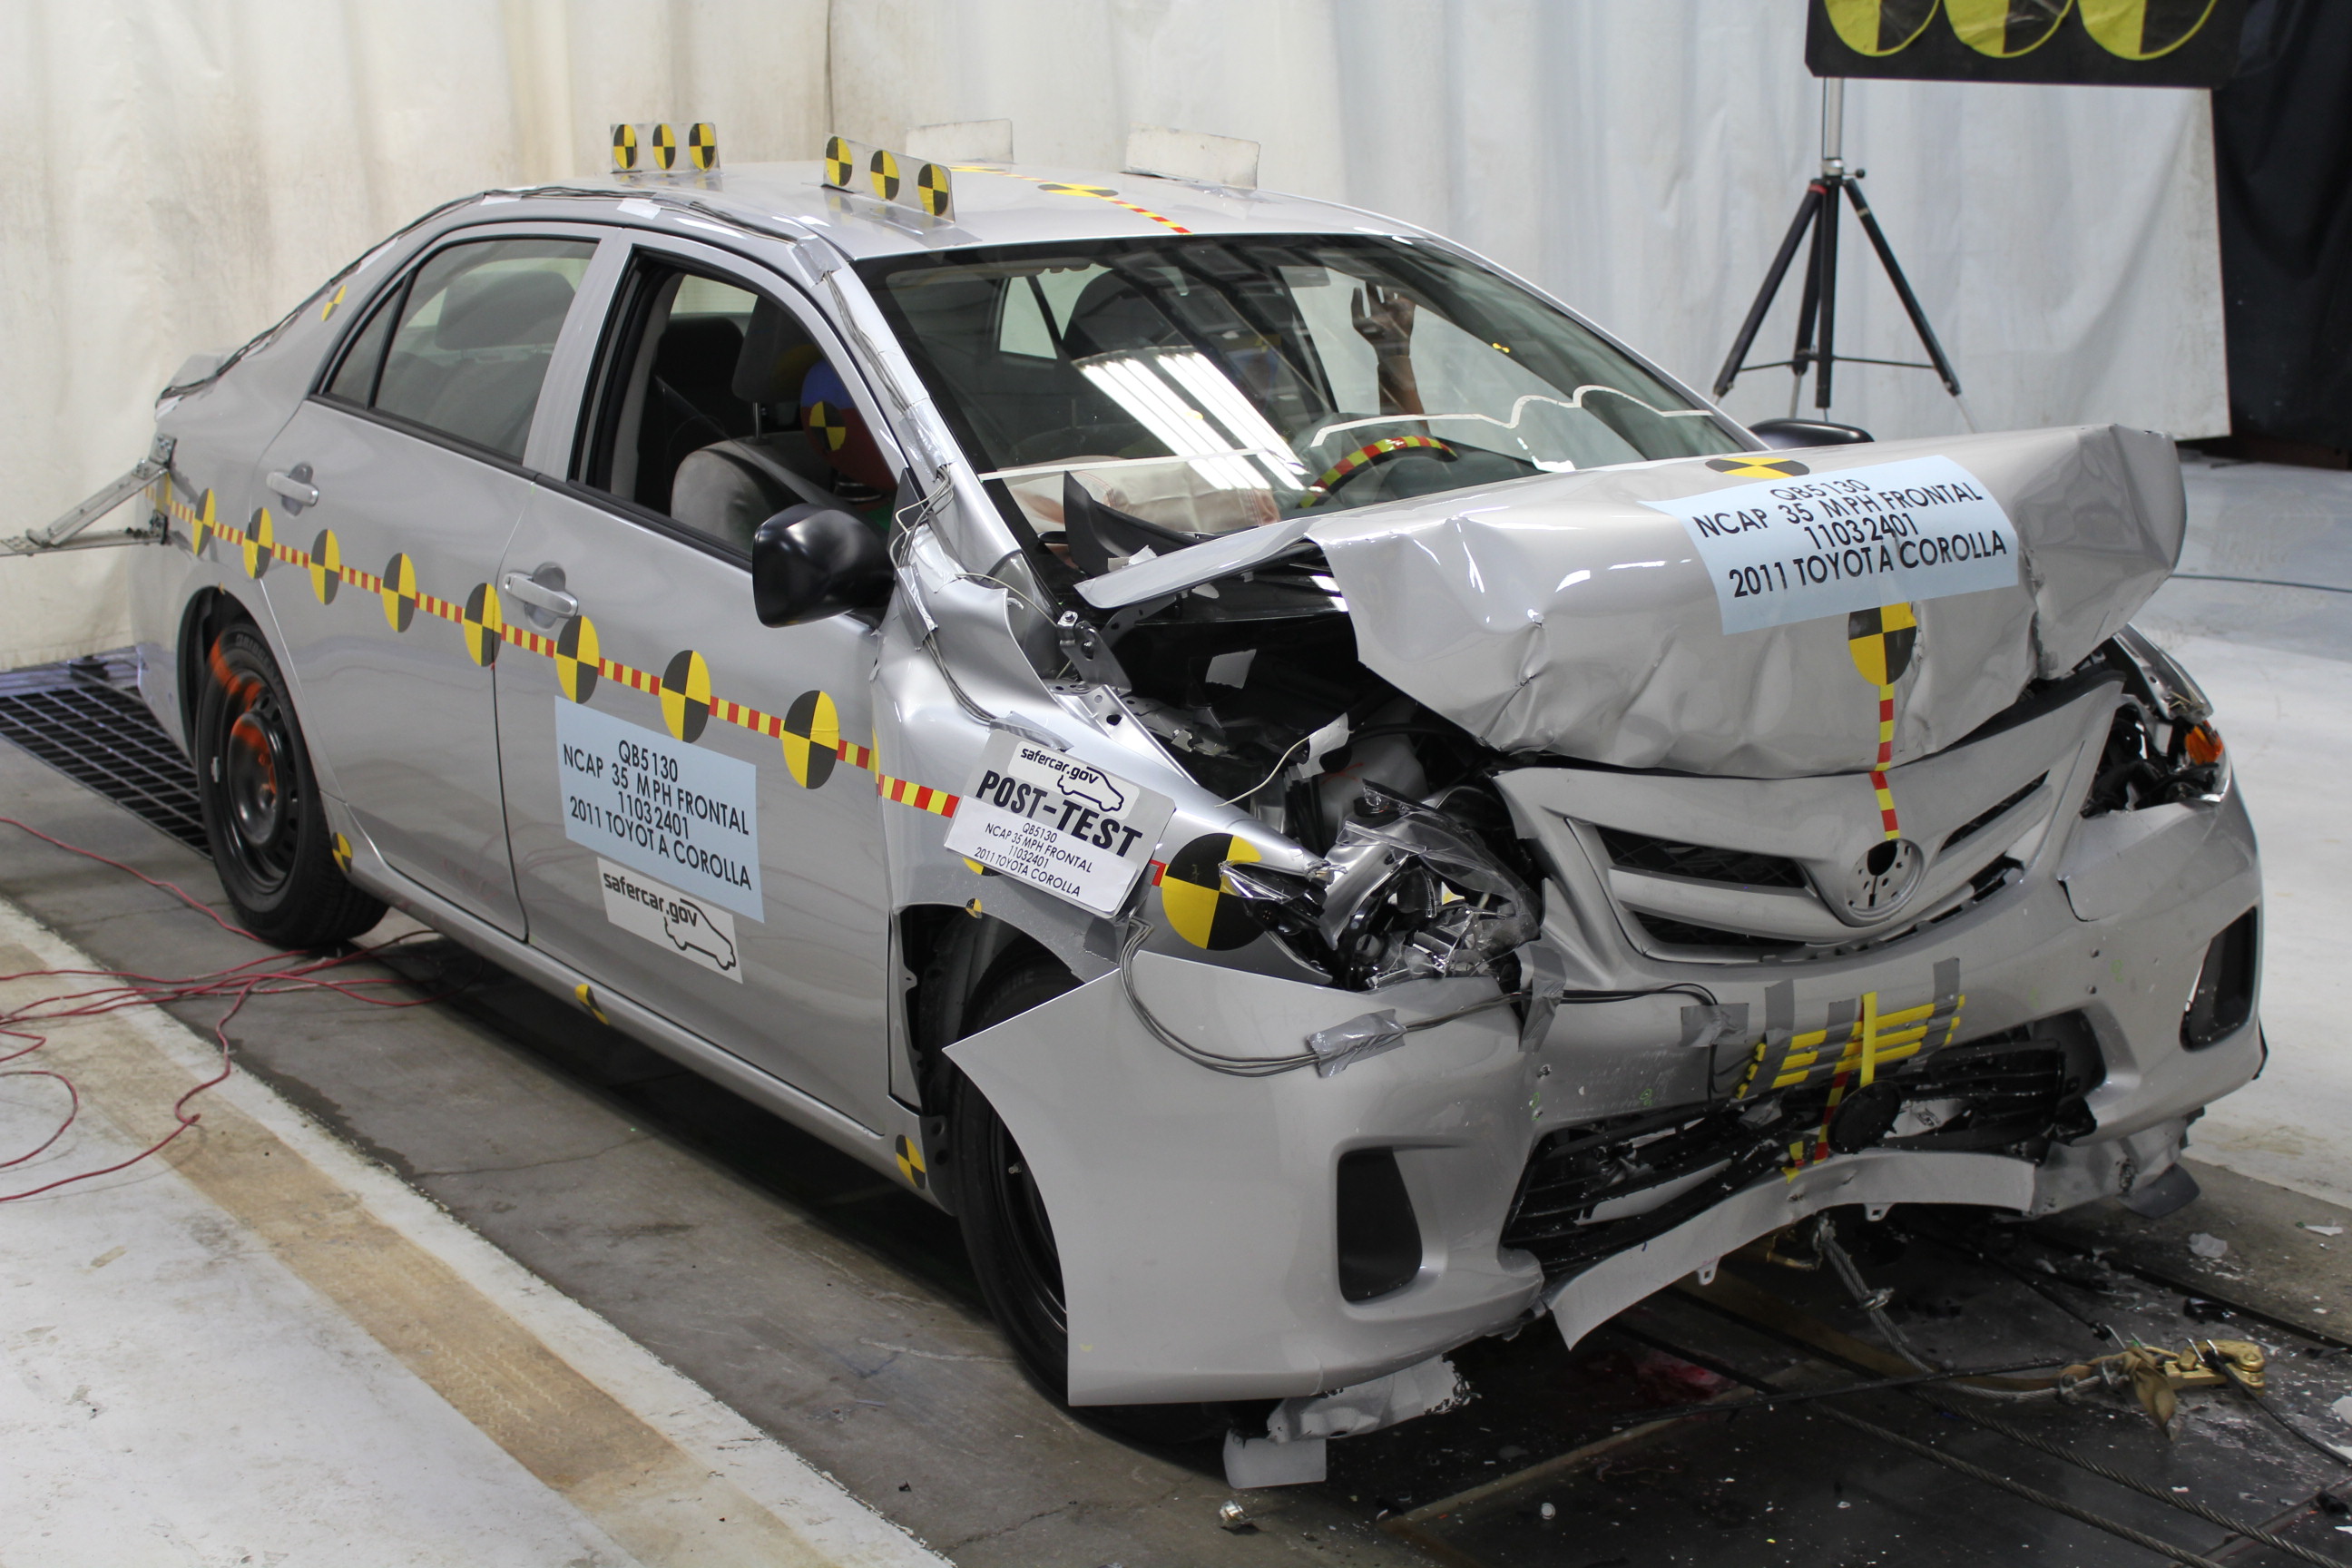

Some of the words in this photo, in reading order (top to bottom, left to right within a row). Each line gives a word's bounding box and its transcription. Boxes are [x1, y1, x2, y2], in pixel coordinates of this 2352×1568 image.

[1692, 507, 1768, 537] NCAP
[1779, 503, 1814, 524] 35
[1818, 494, 1882, 518] MPH
[1884, 482, 1983, 511] FRONTAL
[1770, 479, 1870, 501] QB5130
[1804, 513, 1919, 550] 11032401
[1730, 562, 1788, 597] 2011
[1793, 544, 1894, 586] TOYOTA
[1899, 529, 2007, 569] COROLLA
[619, 740, 678, 782] QB5130
[1021, 749, 1099, 784] safercar.gov
[564, 743, 603, 778] NCAP
[612, 763, 628, 789] 35
[637, 773, 671, 807] MPH
[678, 789, 749, 835] FRONTAL
[975, 769, 1142, 858] POST-TEST
[619, 792, 689, 839] 11032401
[1023, 823, 1057, 843] QB5130
[570, 796, 602, 828] 2011
[606, 810, 670, 858] TOYOTA
[674, 840, 751, 890] COROLLA
[985, 823, 1011, 841] NCAP
[1012, 832, 1023, 845] 35
[1022, 838, 1044, 851] MPH
[1044, 845, 1092, 873] FRONTAL
[1008, 846, 1049, 868] 11032401
[975, 848, 995, 864] 2011
[995, 857, 1028, 876] TOYOTA
[1031, 868, 1081, 897] COROLLA
[603, 873, 697, 926] safercar.gov
